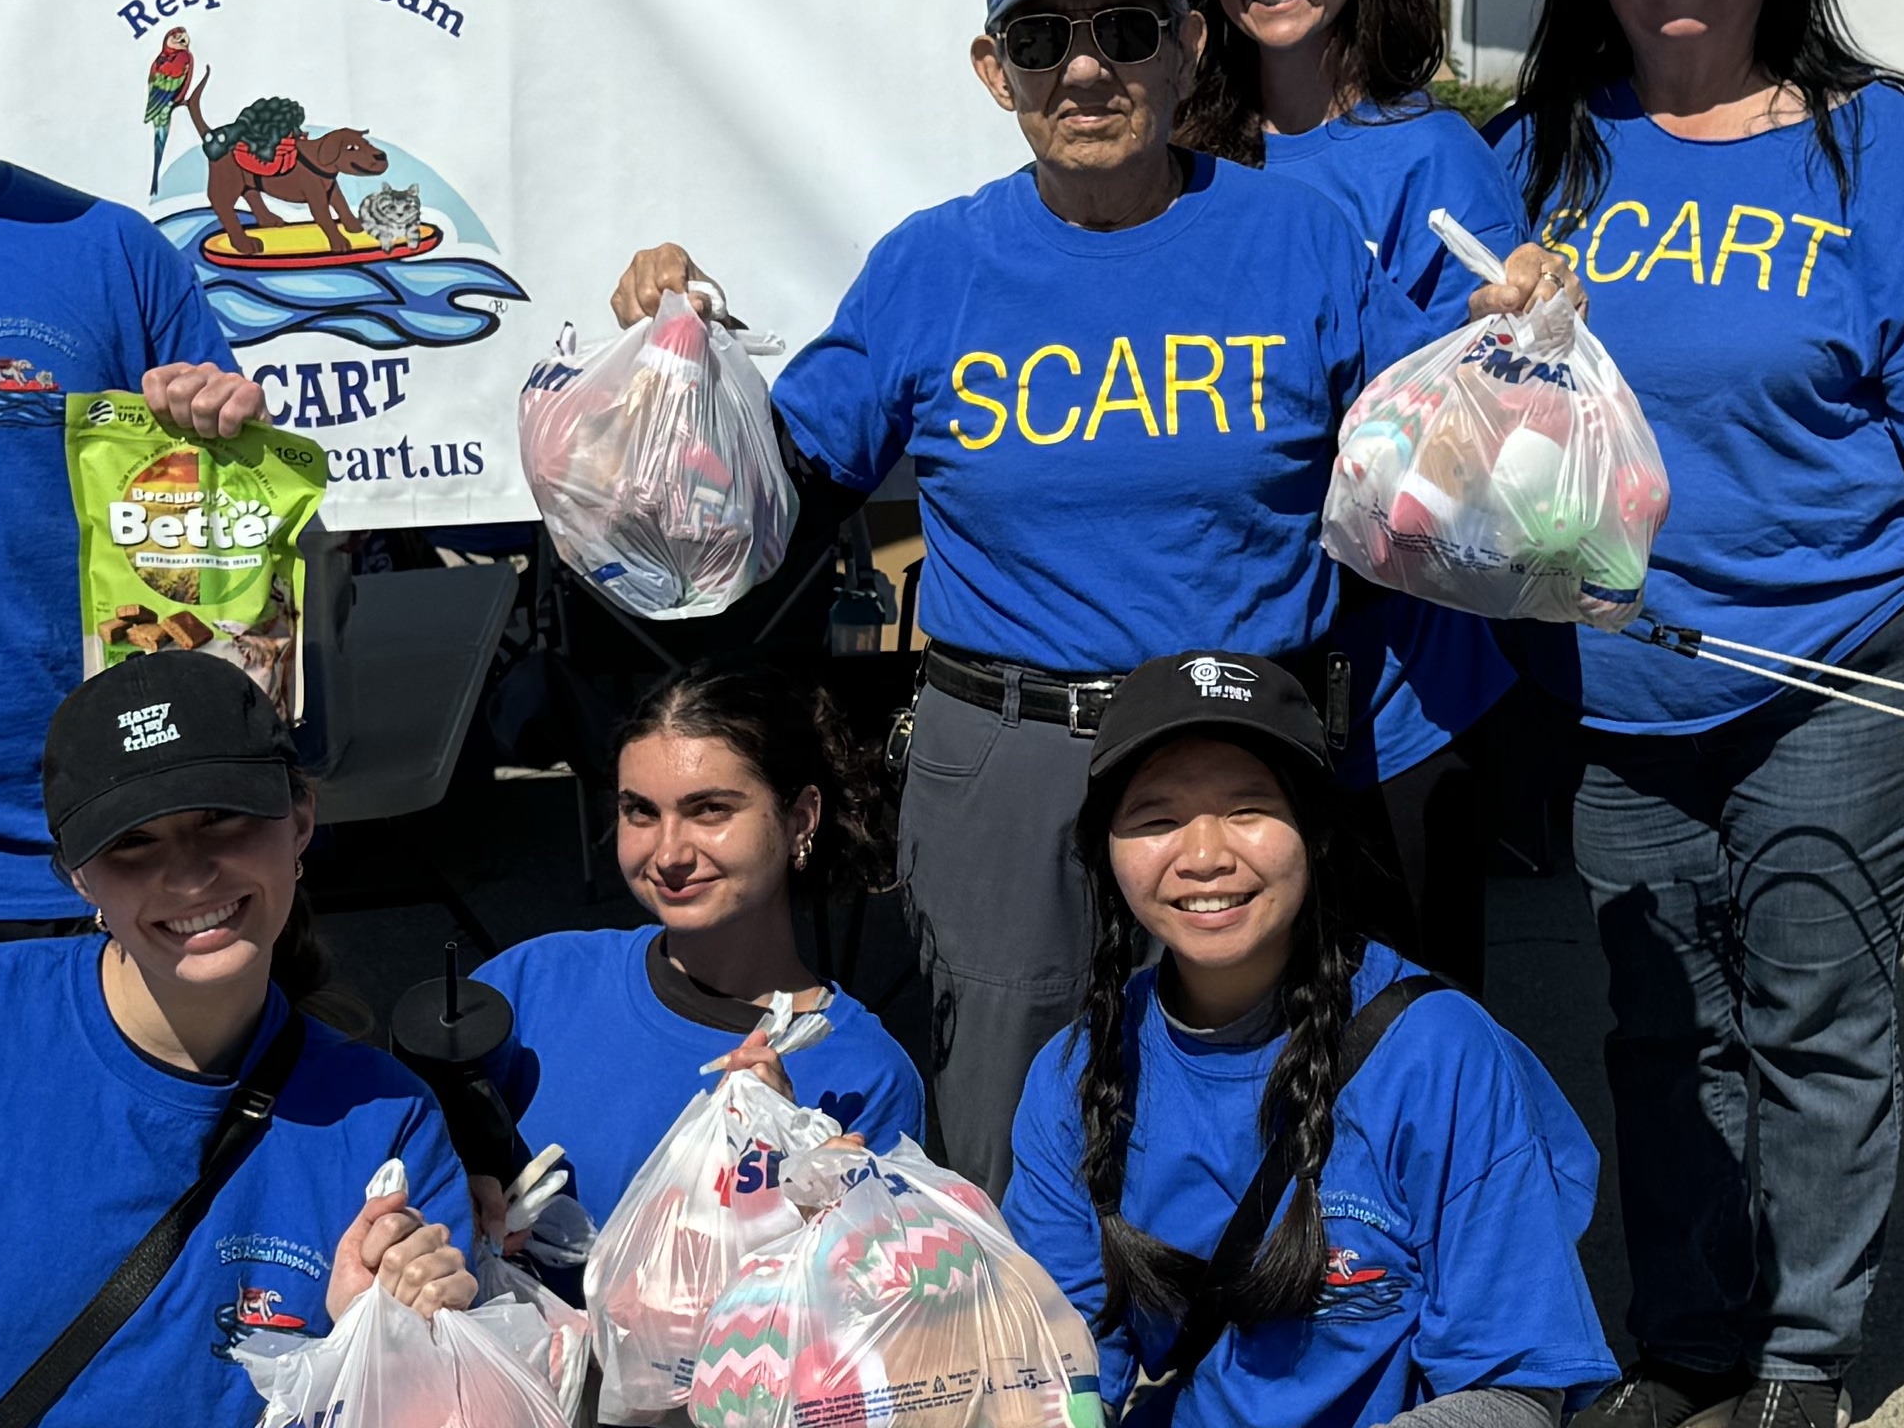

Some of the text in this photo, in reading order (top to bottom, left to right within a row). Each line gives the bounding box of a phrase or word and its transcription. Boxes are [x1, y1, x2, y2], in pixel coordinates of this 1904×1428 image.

[1540, 199, 1851, 297] SCART
[240, 357, 410, 428] CART
[949, 334, 1286, 450] SCART
[118, 411, 145, 423] USA
[275, 447, 313, 465] 160
[131, 487, 204, 504] Because
[117, 703, 171, 729] Harry
[131, 715, 163, 736] is my
[123, 724, 181, 752] friend
[243, 1245, 274, 1262] Animal
[275, 1249, 321, 1279] Response
